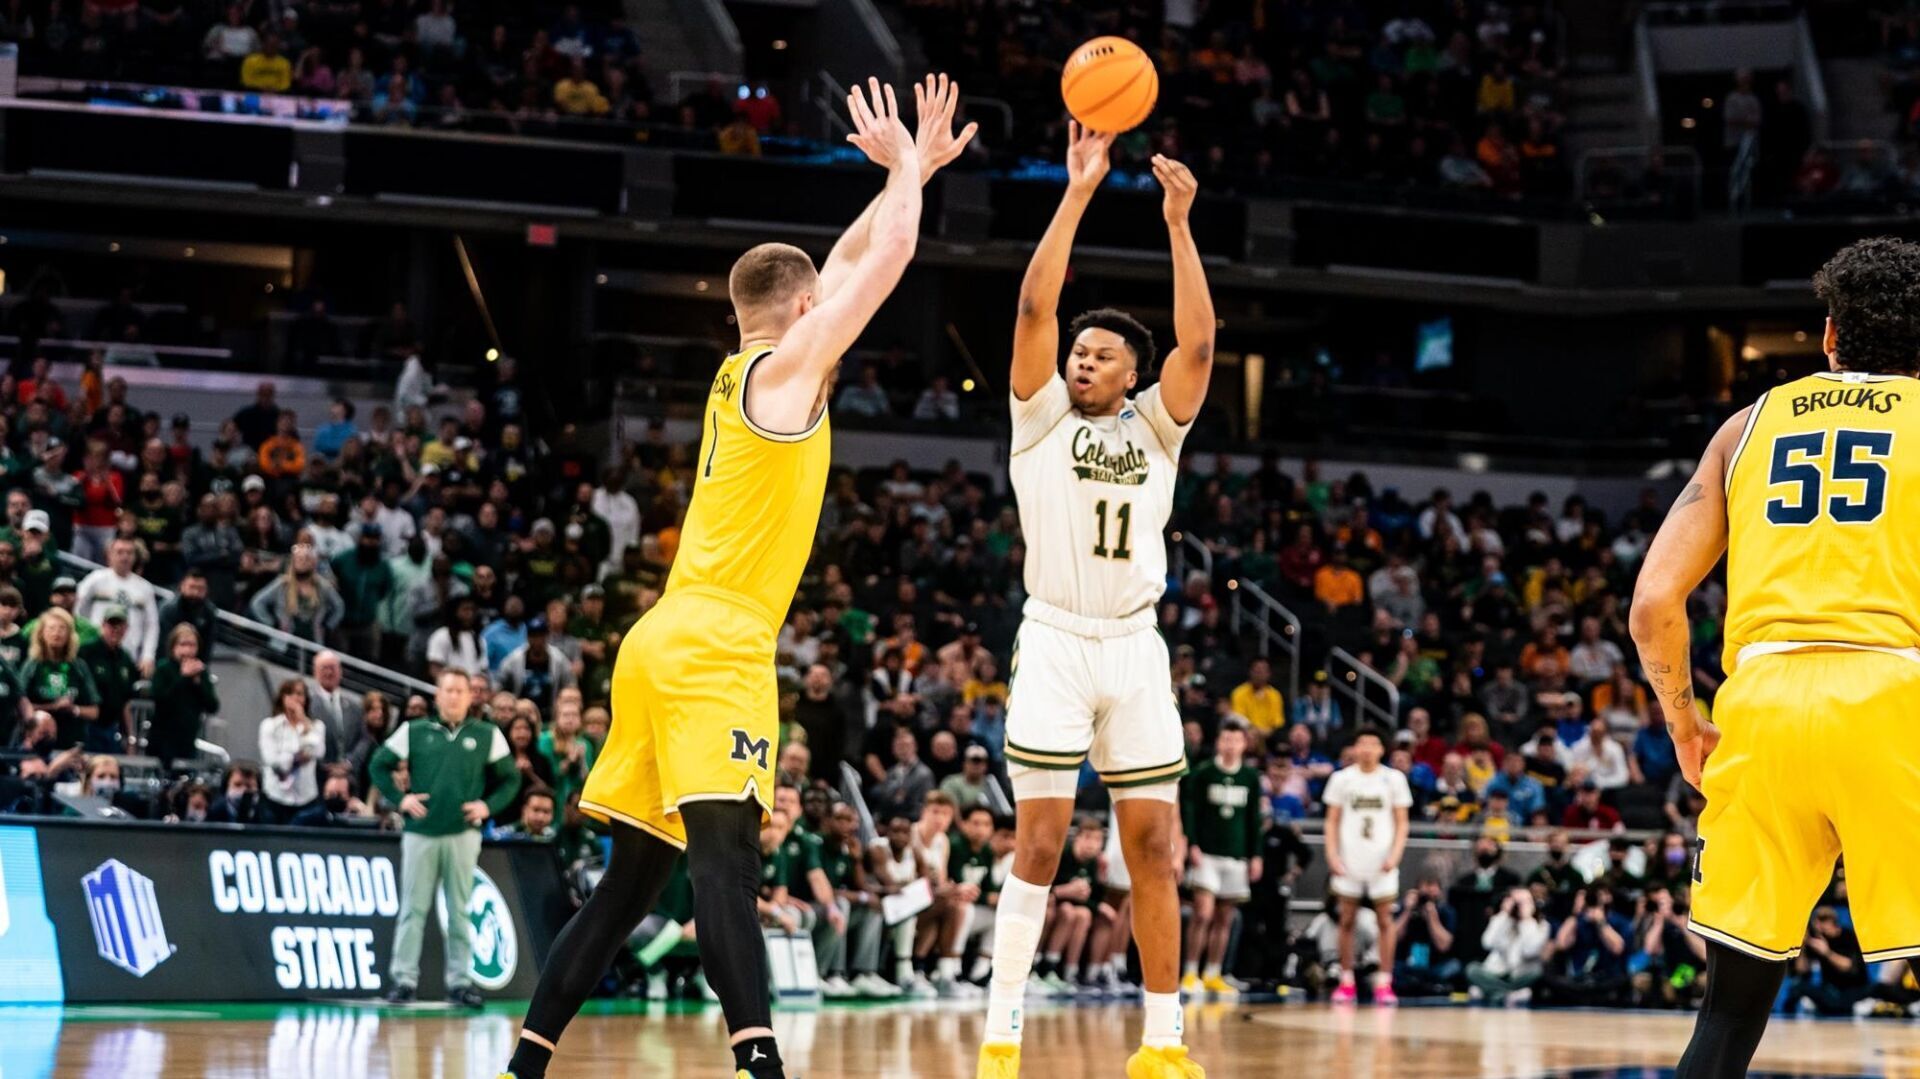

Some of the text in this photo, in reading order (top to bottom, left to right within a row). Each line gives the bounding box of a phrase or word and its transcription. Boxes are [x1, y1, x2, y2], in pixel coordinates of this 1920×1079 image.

[1791, 387, 1902, 418] BROOKS
[1072, 426, 1149, 475] Colorado
[1765, 427, 1895, 527] 55
[1092, 498, 1132, 561] 11
[731, 728, 771, 771] M
[208, 849, 399, 917] COLORADO
[270, 925, 381, 990] STATE
